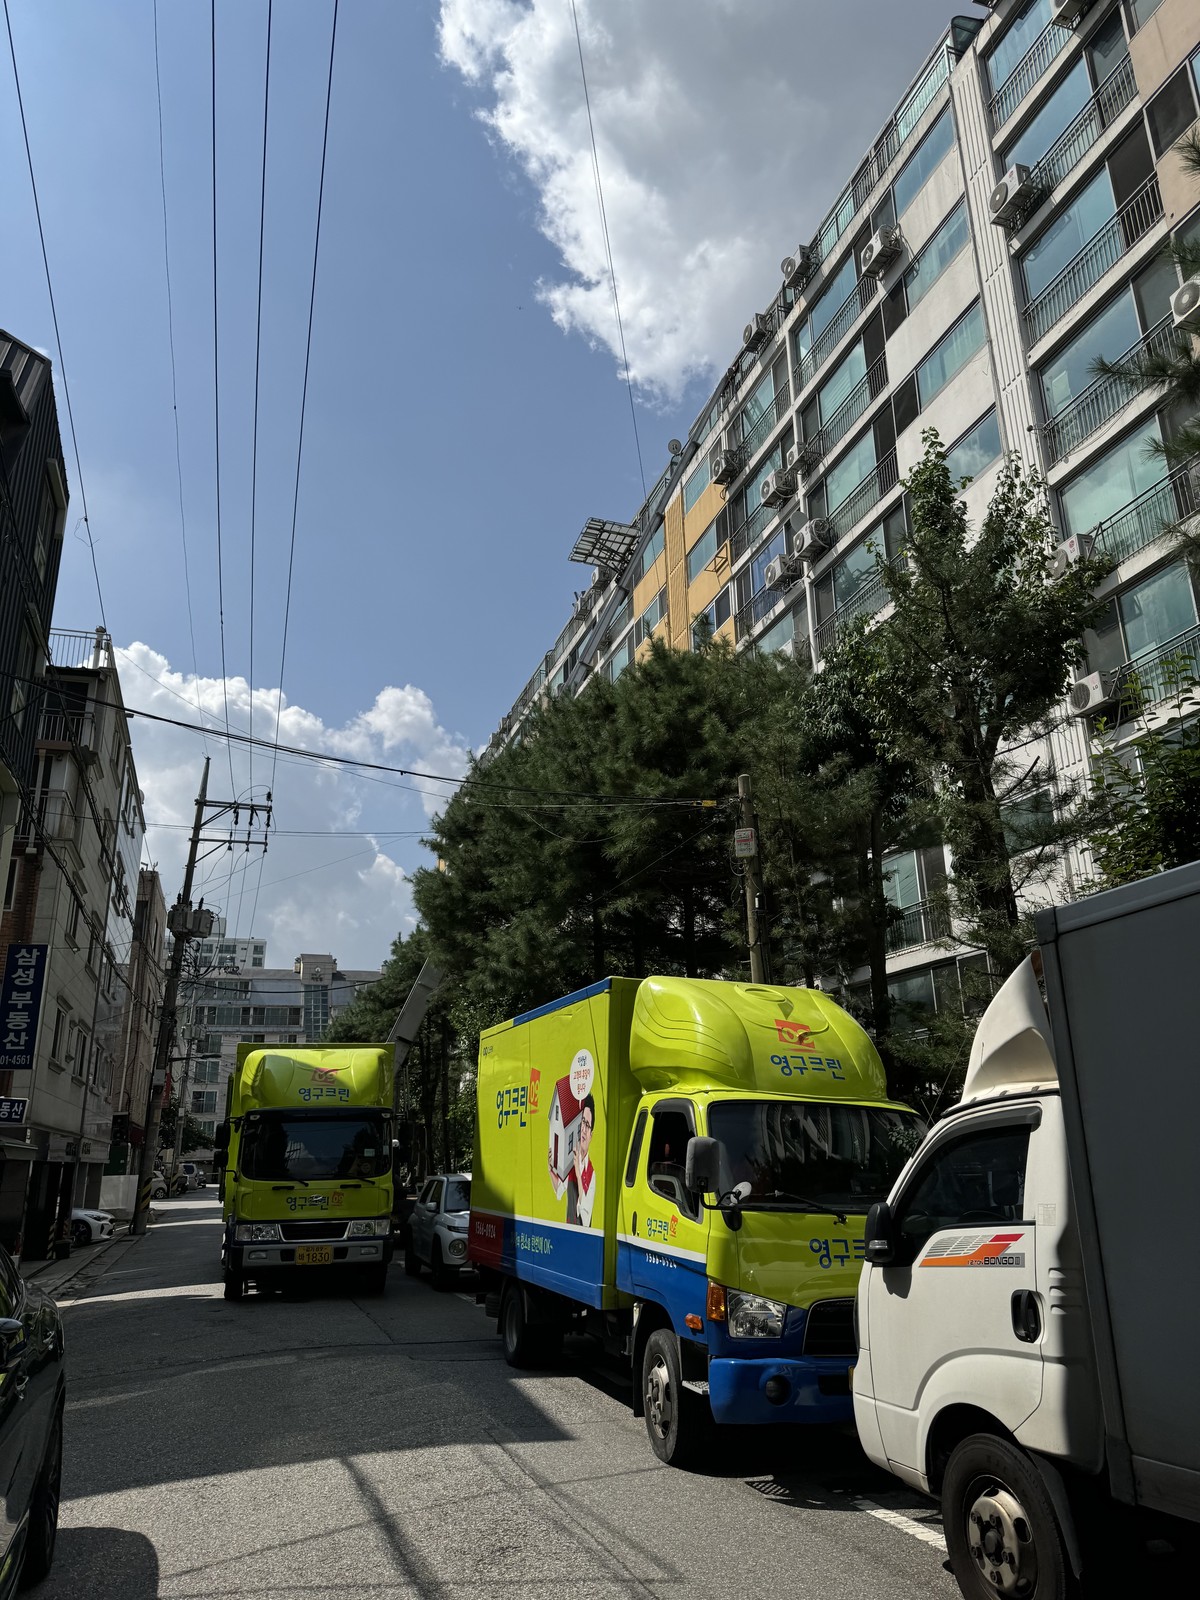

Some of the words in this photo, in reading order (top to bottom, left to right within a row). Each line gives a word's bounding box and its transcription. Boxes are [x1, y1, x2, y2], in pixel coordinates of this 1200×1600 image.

[2, 991, 33, 1050] 부동산
[770, 1054, 846, 1081] 영구크린
[298, 1087, 350, 1102] 영구크린
[496, 1085, 529, 1129] 영구크린
[475, 1222, 496, 1239] 1566-0924
[646, 1217, 669, 1241] 영구크린
[306, 1252, 330, 1263] 1830
[984, 1256, 1014, 1265] BONGO
